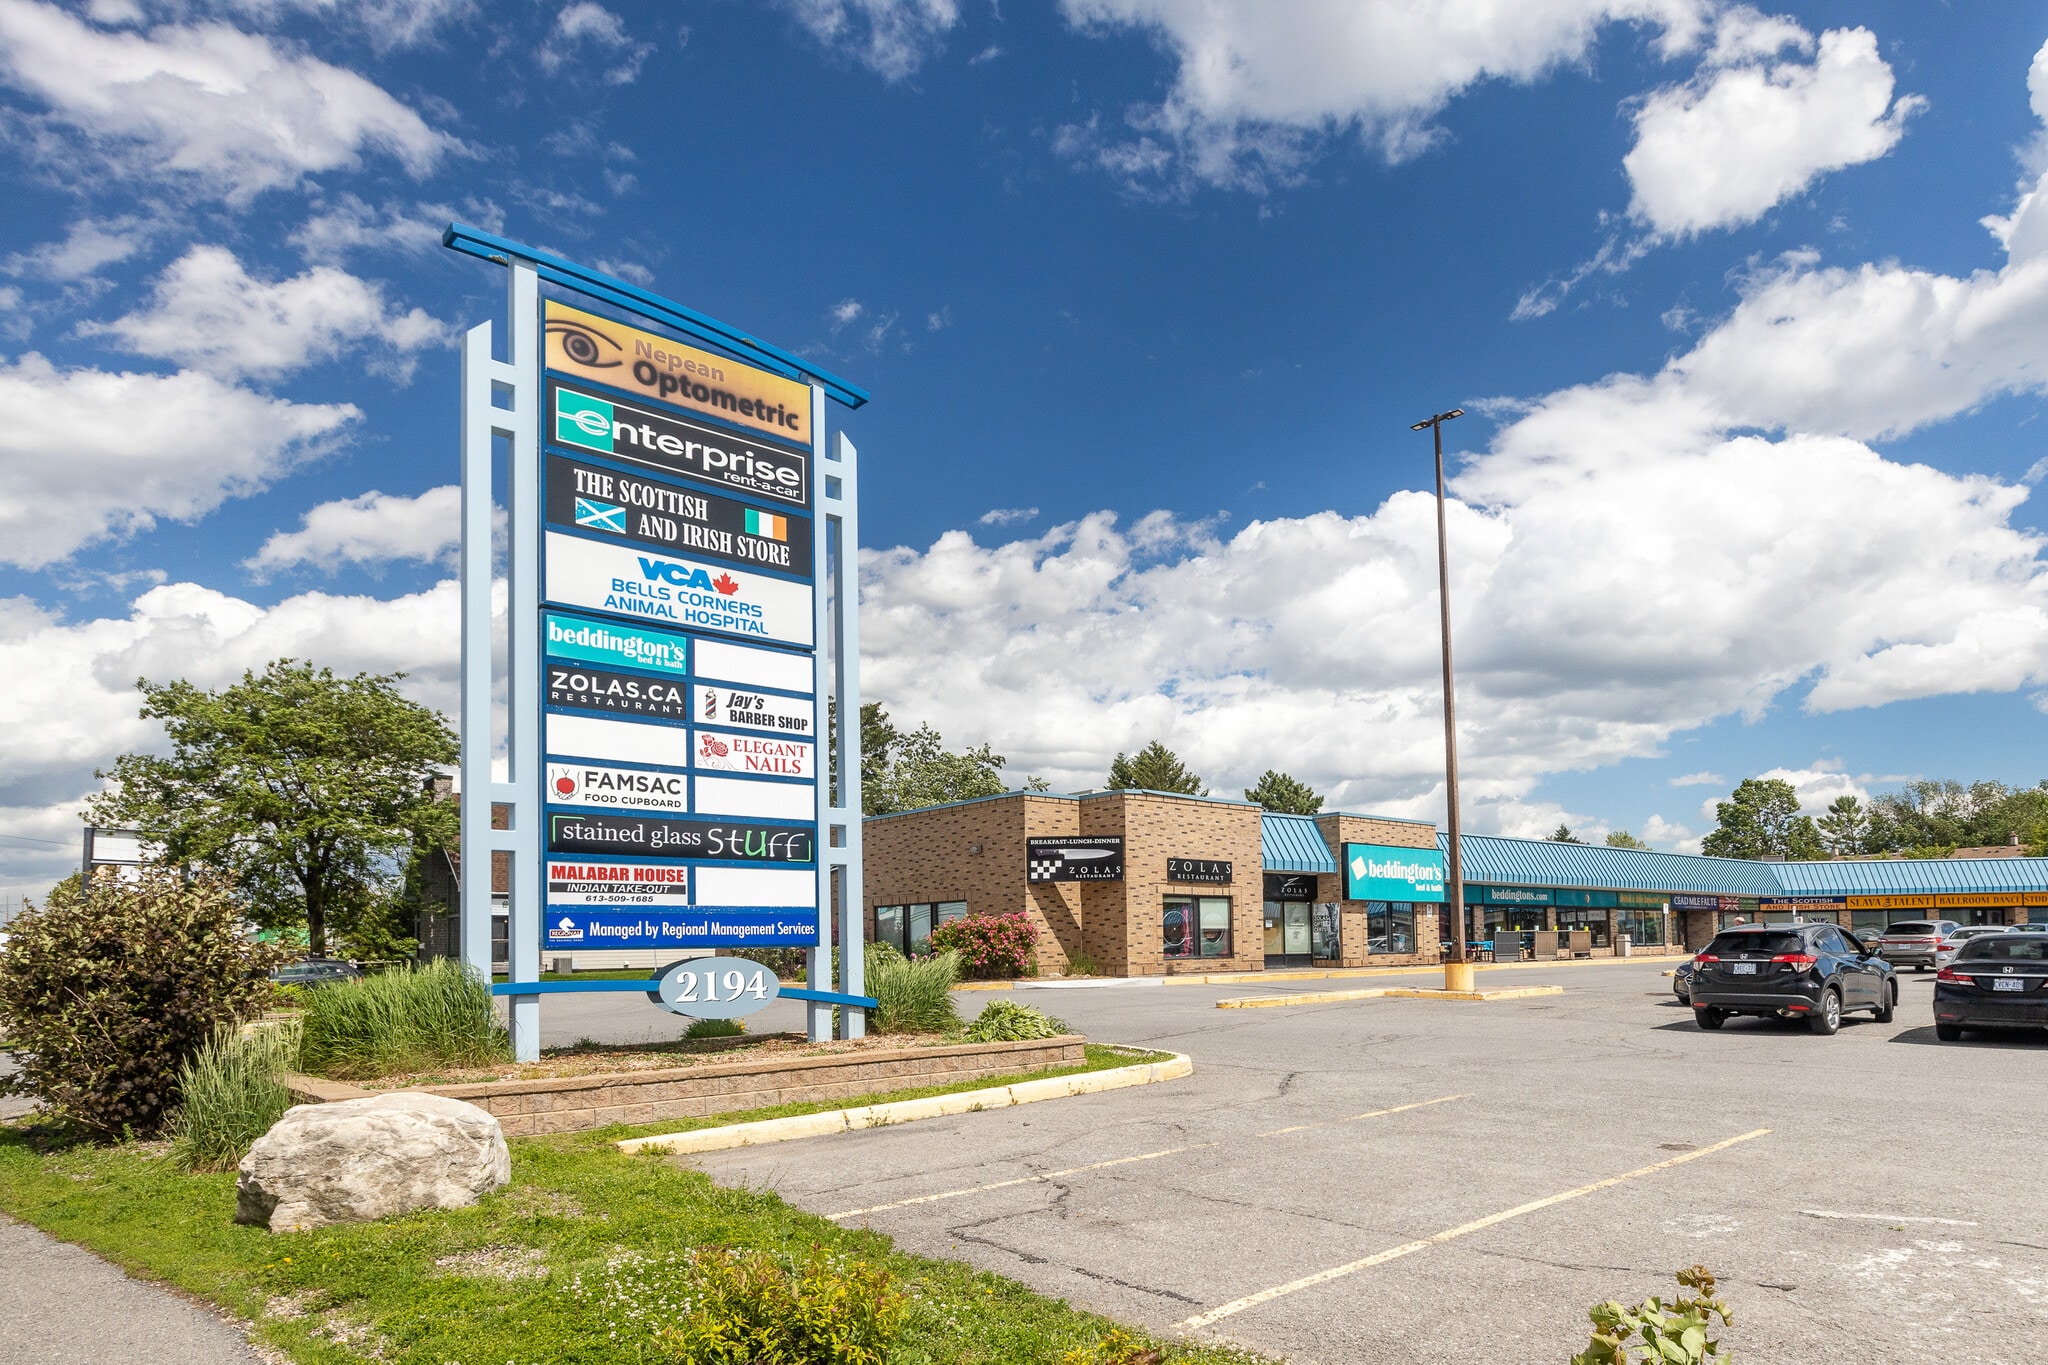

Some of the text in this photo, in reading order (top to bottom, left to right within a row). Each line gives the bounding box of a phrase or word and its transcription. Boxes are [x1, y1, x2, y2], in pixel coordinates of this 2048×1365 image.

[635, 338, 725, 382] Nepean
[633, 361, 799, 431] Optometric
[574, 410, 800, 487] enterprise
[574, 468, 708, 522] THE SCOTTISH
[724, 471, 800, 498] rent-a-car
[638, 514, 790, 566] AND IRISH STORE
[637, 557, 714, 592] VCA
[611, 577, 763, 618] BELLS CORNERS
[604, 595, 769, 635] ANIMAL HOSPITAL
[549, 621, 685, 661] beddington's
[637, 655, 683, 669] bed & bath
[552, 671, 683, 704] ZOLAS.CA
[552, 691, 683, 714] RESTAURANT
[726, 692, 765, 710] Jay's
[729, 709, 808, 731] BARBER SHOP
[733, 739, 807, 758] ELEGANT
[745, 755, 801, 774] NAILS
[585, 771, 682, 795] FAMSAC
[584, 793, 682, 808] FOOD CUPBOARD
[562, 822, 645, 843] stained
[650, 826, 701, 848] glass
[551, 865, 684, 883] MALABAR HOUSE
[1069, 865, 1121, 874] ZOLAS
[1169, 860, 1231, 874] ZOLAS
[1177, 873, 1224, 881] RESTAURANT
[1368, 859, 1442, 884] beddington's
[567, 883, 670, 894] INDIAN TAKE-OUT
[585, 895, 654, 903] 613-509-1685
[1491, 889, 1548, 902] beddingtons.com
[1850, 897, 1931, 906] SLAVA TALENT
[1939, 896, 1990, 905] BALLROOM
[589, 921, 815, 939] Managed by Regional Management Services
[675, 970, 769, 1003] 2194
